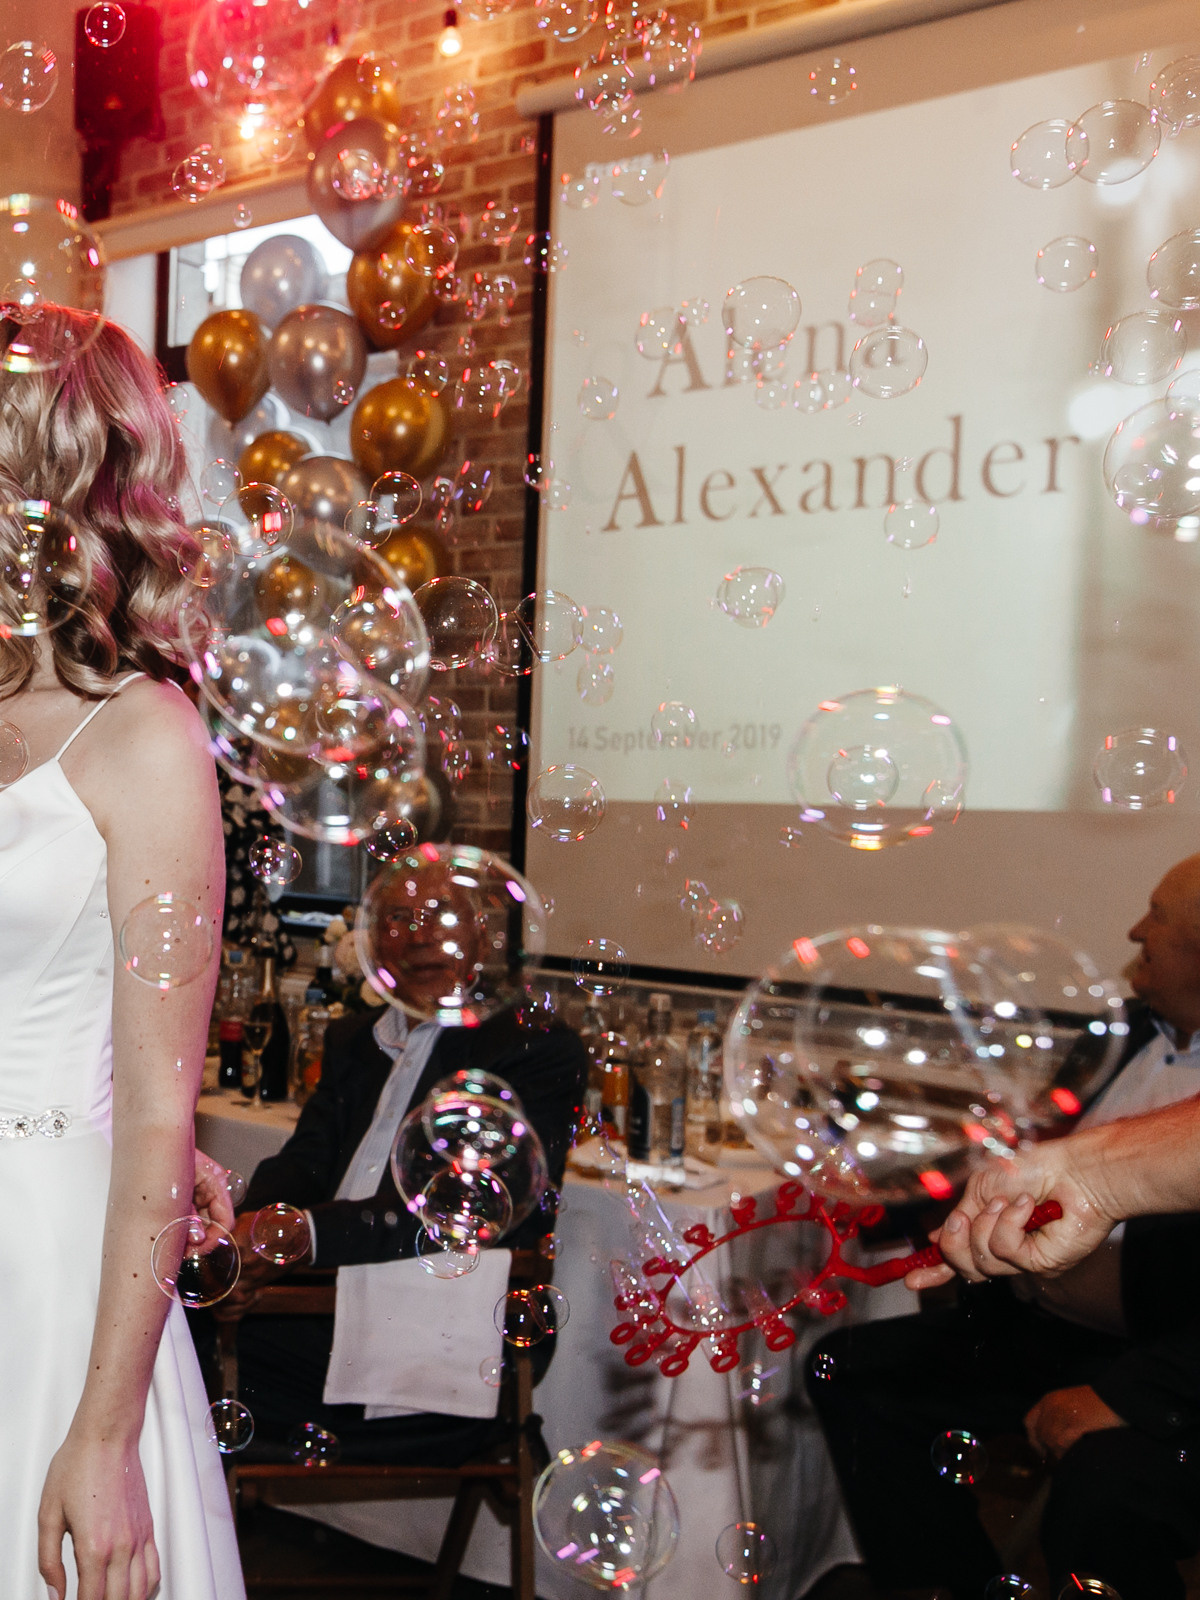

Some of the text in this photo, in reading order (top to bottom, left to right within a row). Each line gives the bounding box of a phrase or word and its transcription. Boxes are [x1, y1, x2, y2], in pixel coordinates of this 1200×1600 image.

[600, 413, 1082, 532] Alexander
[568, 722, 783, 757] 14 September 2019
